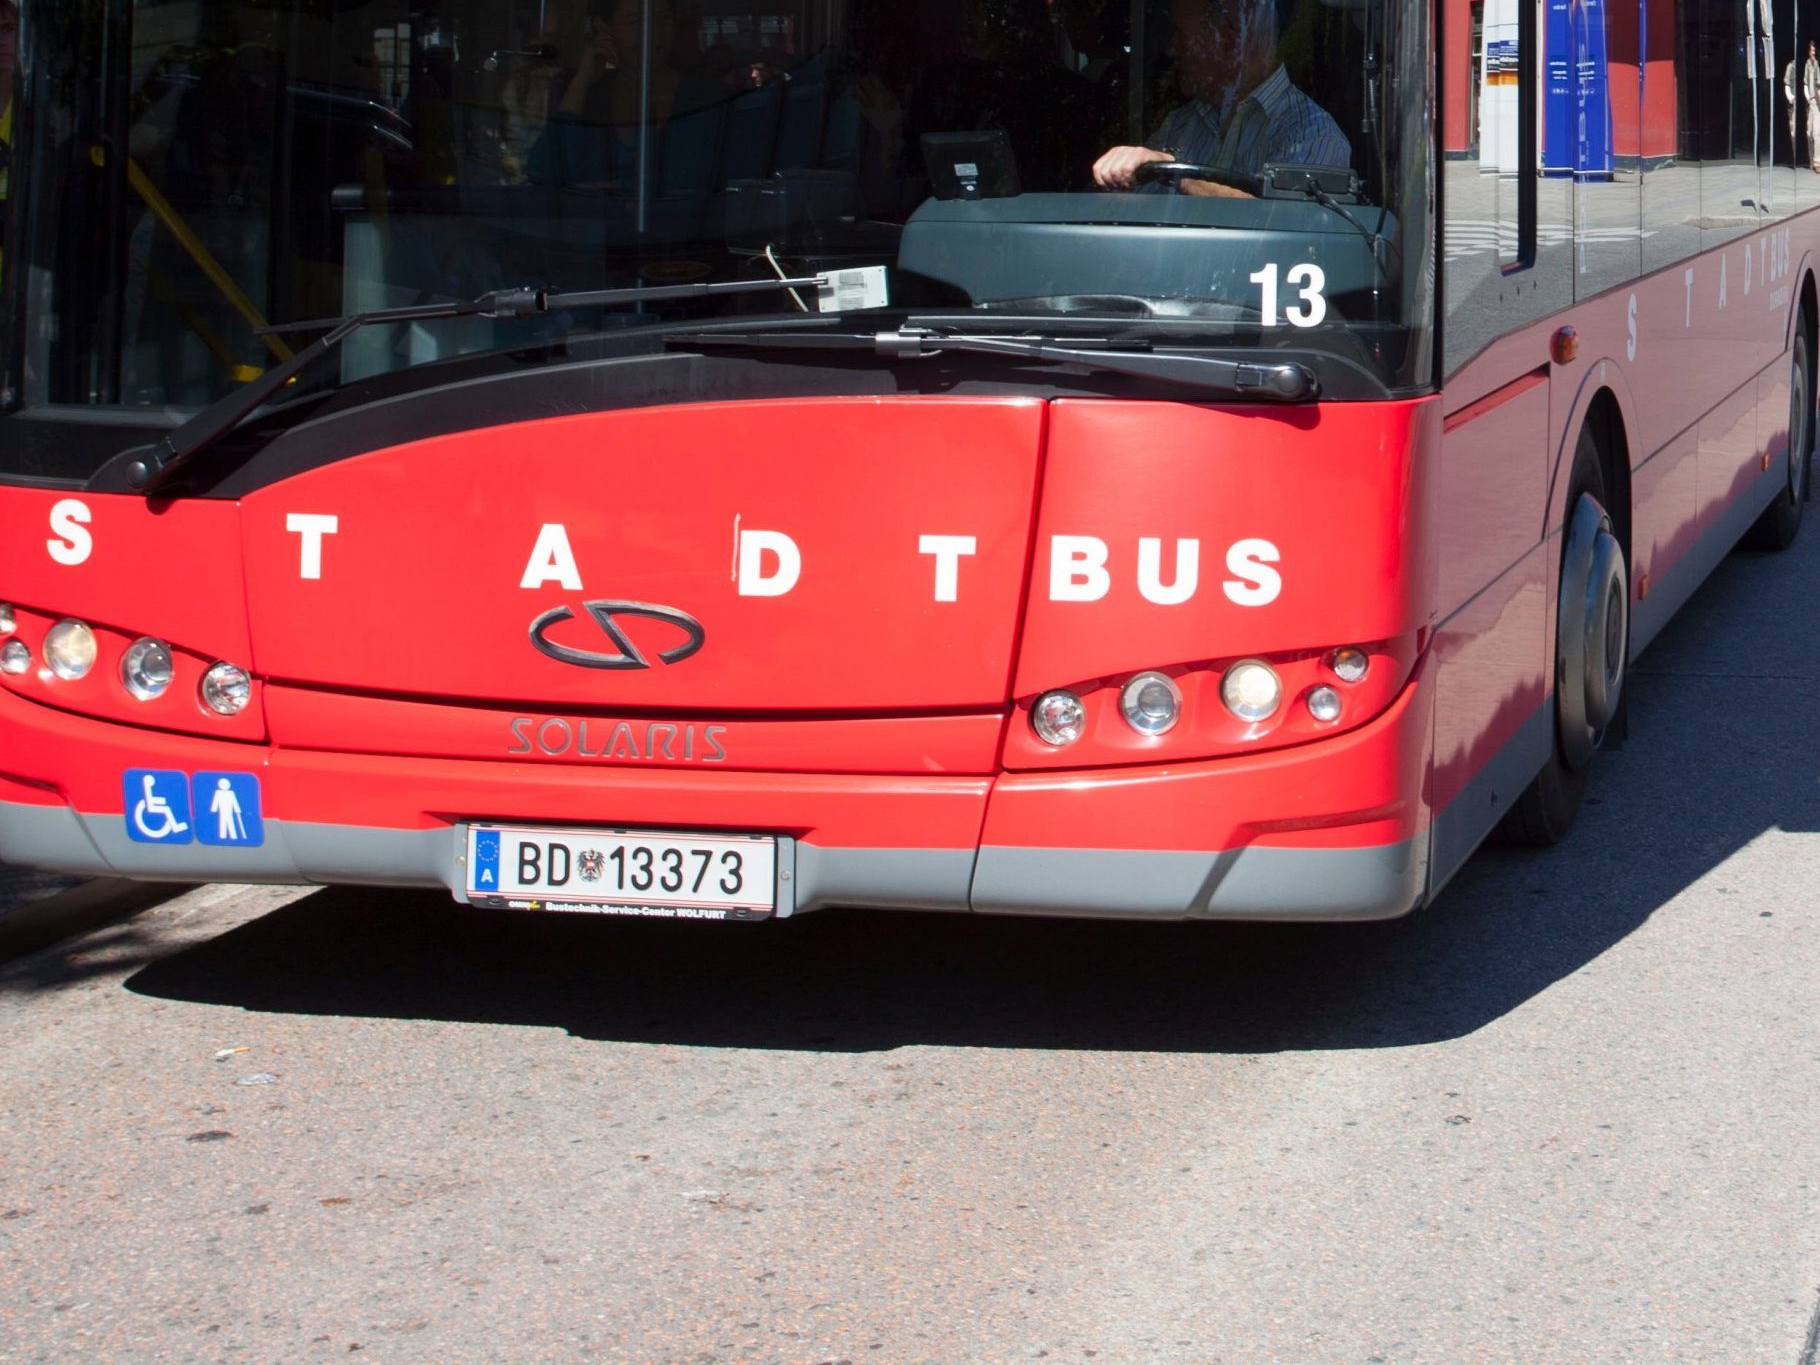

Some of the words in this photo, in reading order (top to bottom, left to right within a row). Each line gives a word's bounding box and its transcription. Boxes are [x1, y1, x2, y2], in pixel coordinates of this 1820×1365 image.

[1249, 262, 1328, 328] 13
[508, 717, 728, 762] SOLARIS
[480, 868, 494, 884] A
[518, 841, 571, 887] BD
[609, 845, 744, 896] 13373
[676, 908, 727, 920] WOLFURT
